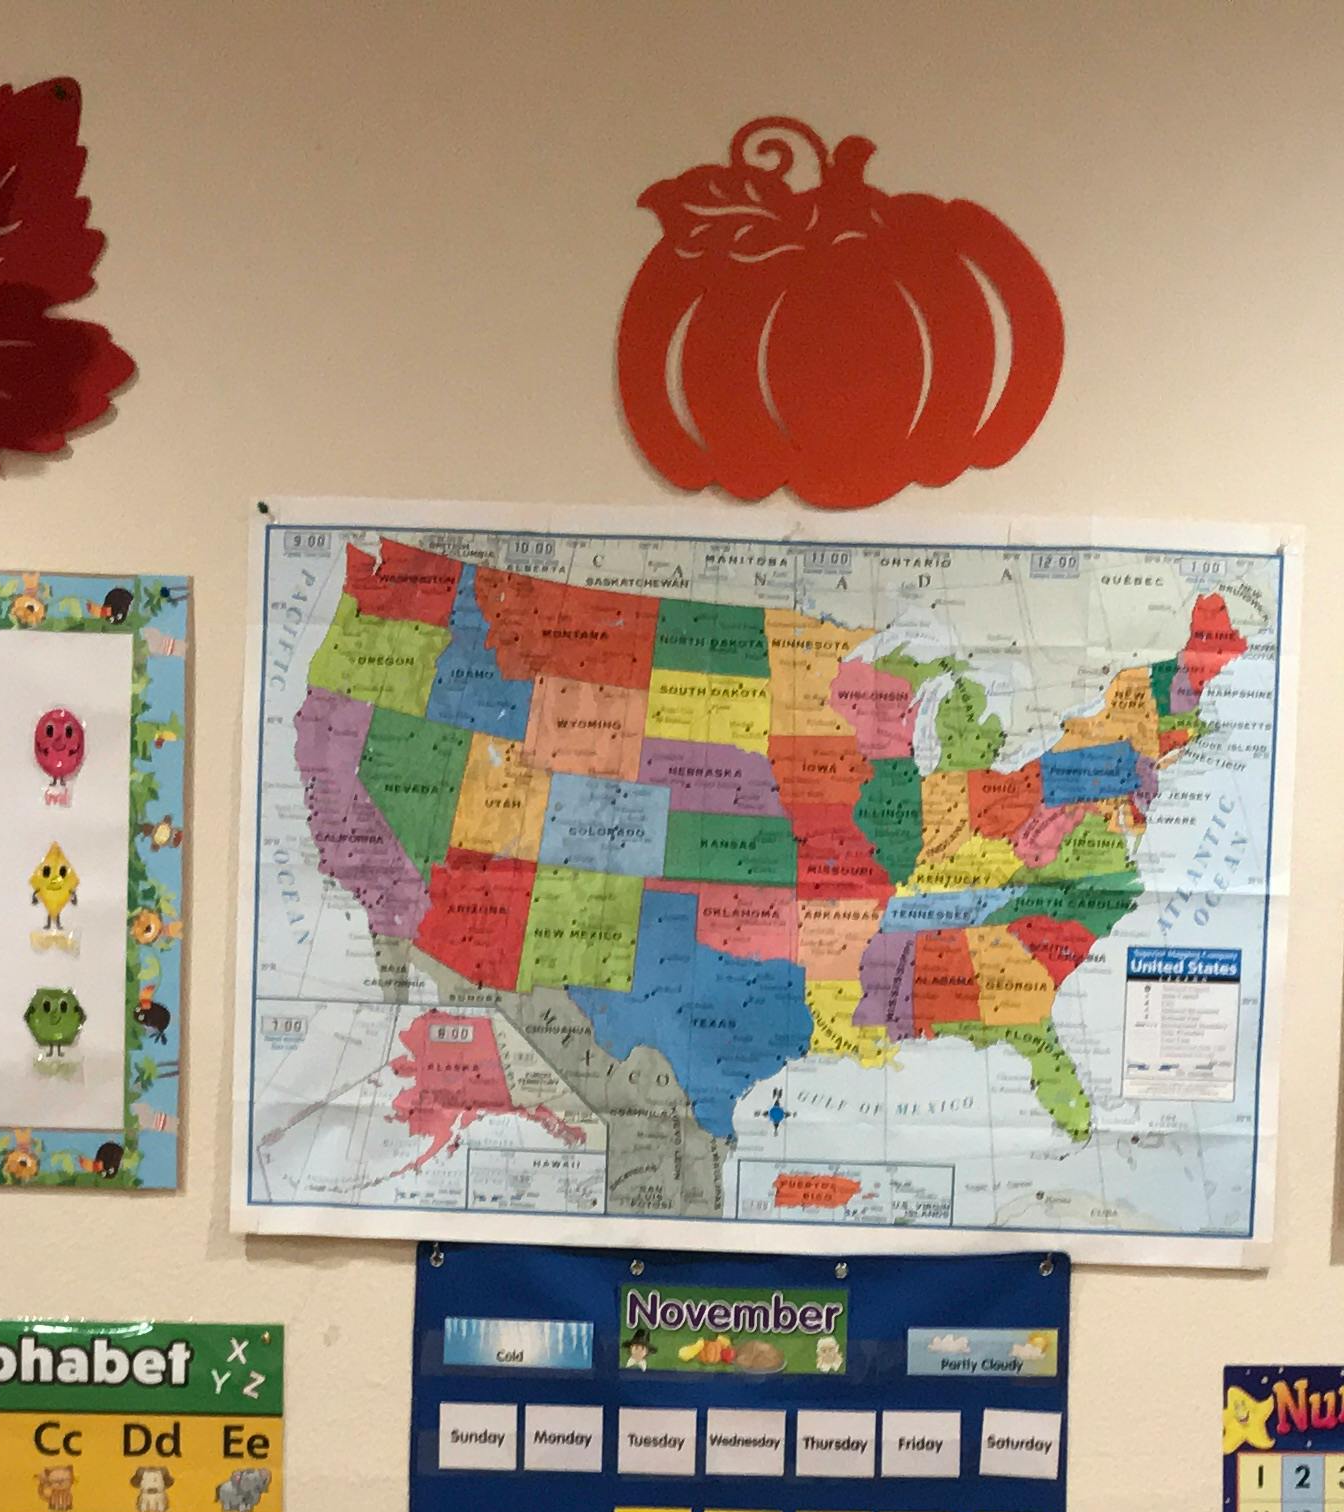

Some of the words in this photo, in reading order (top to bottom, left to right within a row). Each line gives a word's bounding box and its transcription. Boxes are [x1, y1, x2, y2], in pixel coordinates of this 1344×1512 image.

[542, 630, 608, 640] MONTANA
[659, 636, 706, 647] NORTH
[710, 637, 765, 649] DAKOTA
[771, 639, 850, 651] MINNESOTA
[356, 655, 415, 667] OREGON
[450, 669, 495, 680] IDAHO
[659, 685, 706, 697] SOUTH
[711, 687, 767, 699] DAKOTA
[1114, 689, 1145, 700] NEW
[1111, 700, 1146, 710] YORK
[557, 719, 622, 731] WYOMING
[802, 763, 837, 774] IOWA
[384, 784, 439, 795] NEVADA
[858, 808, 918, 820] ILLINOIS
[569, 826, 645, 839] COLORADO
[1065, 838, 1125, 850] VIRGINIA
[916, 873, 991, 886] KENTUCKY
[803, 909, 880, 921] ARKANSAS
[891, 909, 971, 921] TENNESSEE
[534, 928, 564, 940] NEW
[571, 929, 622, 942] MEXICO
[1130, 959, 1177, 974] United
[1180, 960, 1237, 977] States
[985, 980, 1047, 992] GEORGIA
[691, 1017, 736, 1029] TEXAS
[627, 1290, 844, 1333] November
[496, 1349, 524, 1363] Cold
[941, 1358, 977, 1373] Partly
[982, 1358, 1024, 1374] Cloudy
[33, 1421, 83, 1457] Cc
[123, 1423, 182, 1458] Dd
[222, 1426, 271, 1460] Ee
[450, 1429, 506, 1448] Sunday
[534, 1429, 592, 1448] Monday
[628, 1434, 685, 1453] Tuesday
[709, 1434, 781, 1452] Wednesday
[802, 1435, 868, 1455] Thursday
[897, 1435, 943, 1454] Friday
[987, 1435, 1053, 1456] Saturday
[1256, 1465, 1265, 1489] 1
[1294, 1465, 1311, 1489] 2
